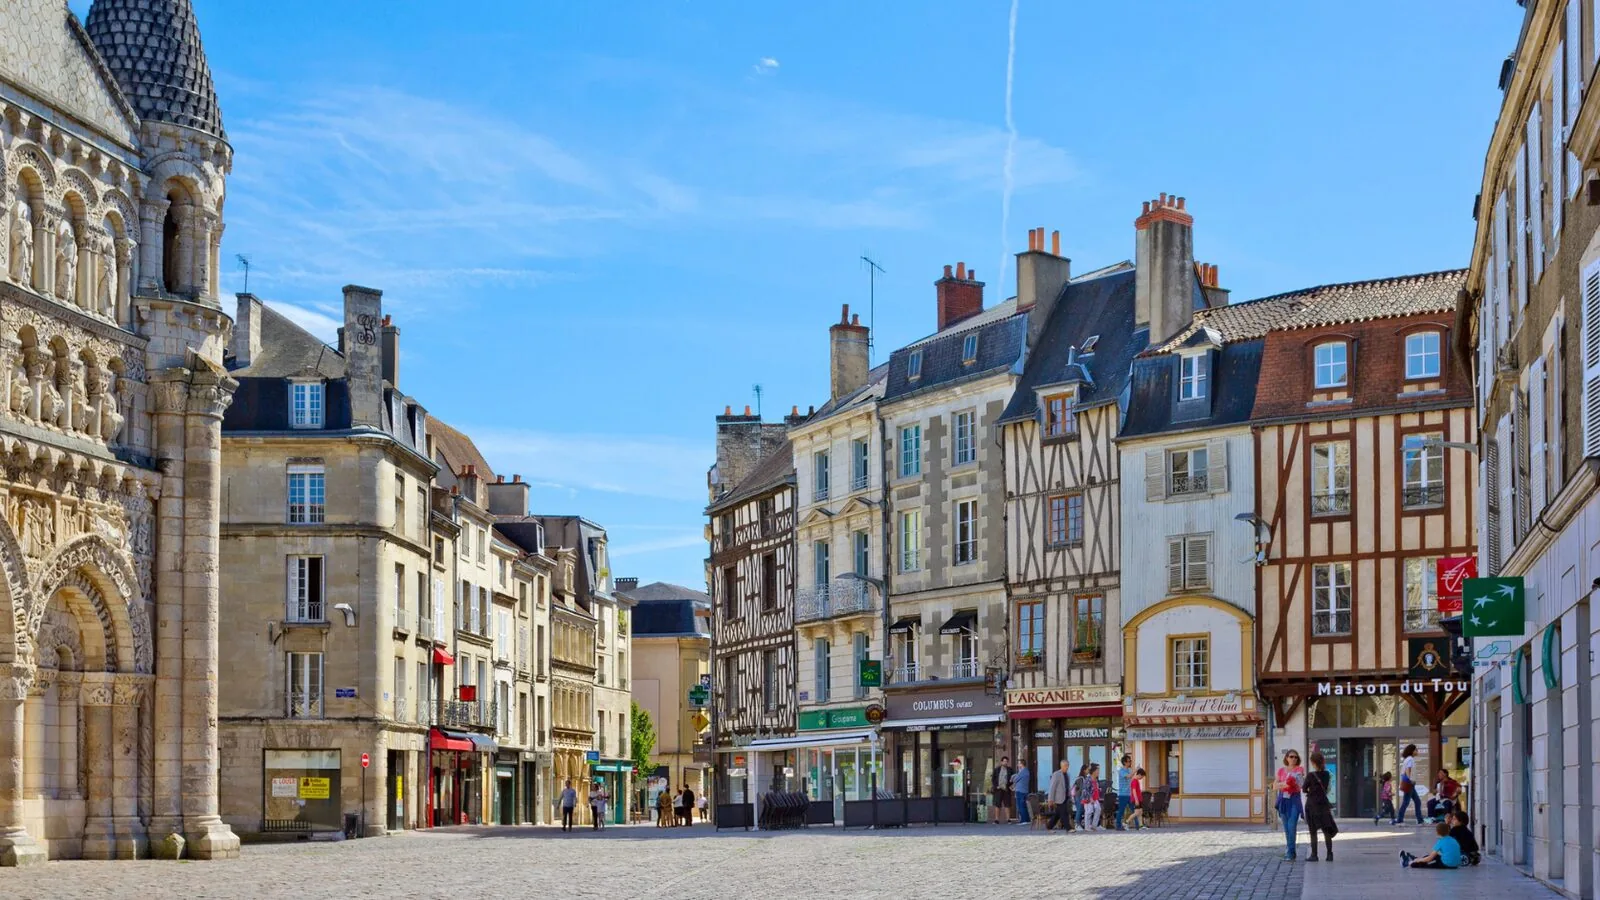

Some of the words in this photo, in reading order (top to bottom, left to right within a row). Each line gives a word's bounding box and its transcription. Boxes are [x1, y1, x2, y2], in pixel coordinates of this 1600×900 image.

[1318, 682, 1389, 696] Maison
[1400, 680, 1423, 693] du
[1431, 678, 1467, 692] Tou
[1008, 690, 1084, 704] L'ARGANIER
[912, 699, 954, 711] COLUMBUS
[1199, 698, 1238, 712] d'Elina
[831, 714, 857, 724] Groupama
[1064, 728, 1108, 738] RESTAURANT
